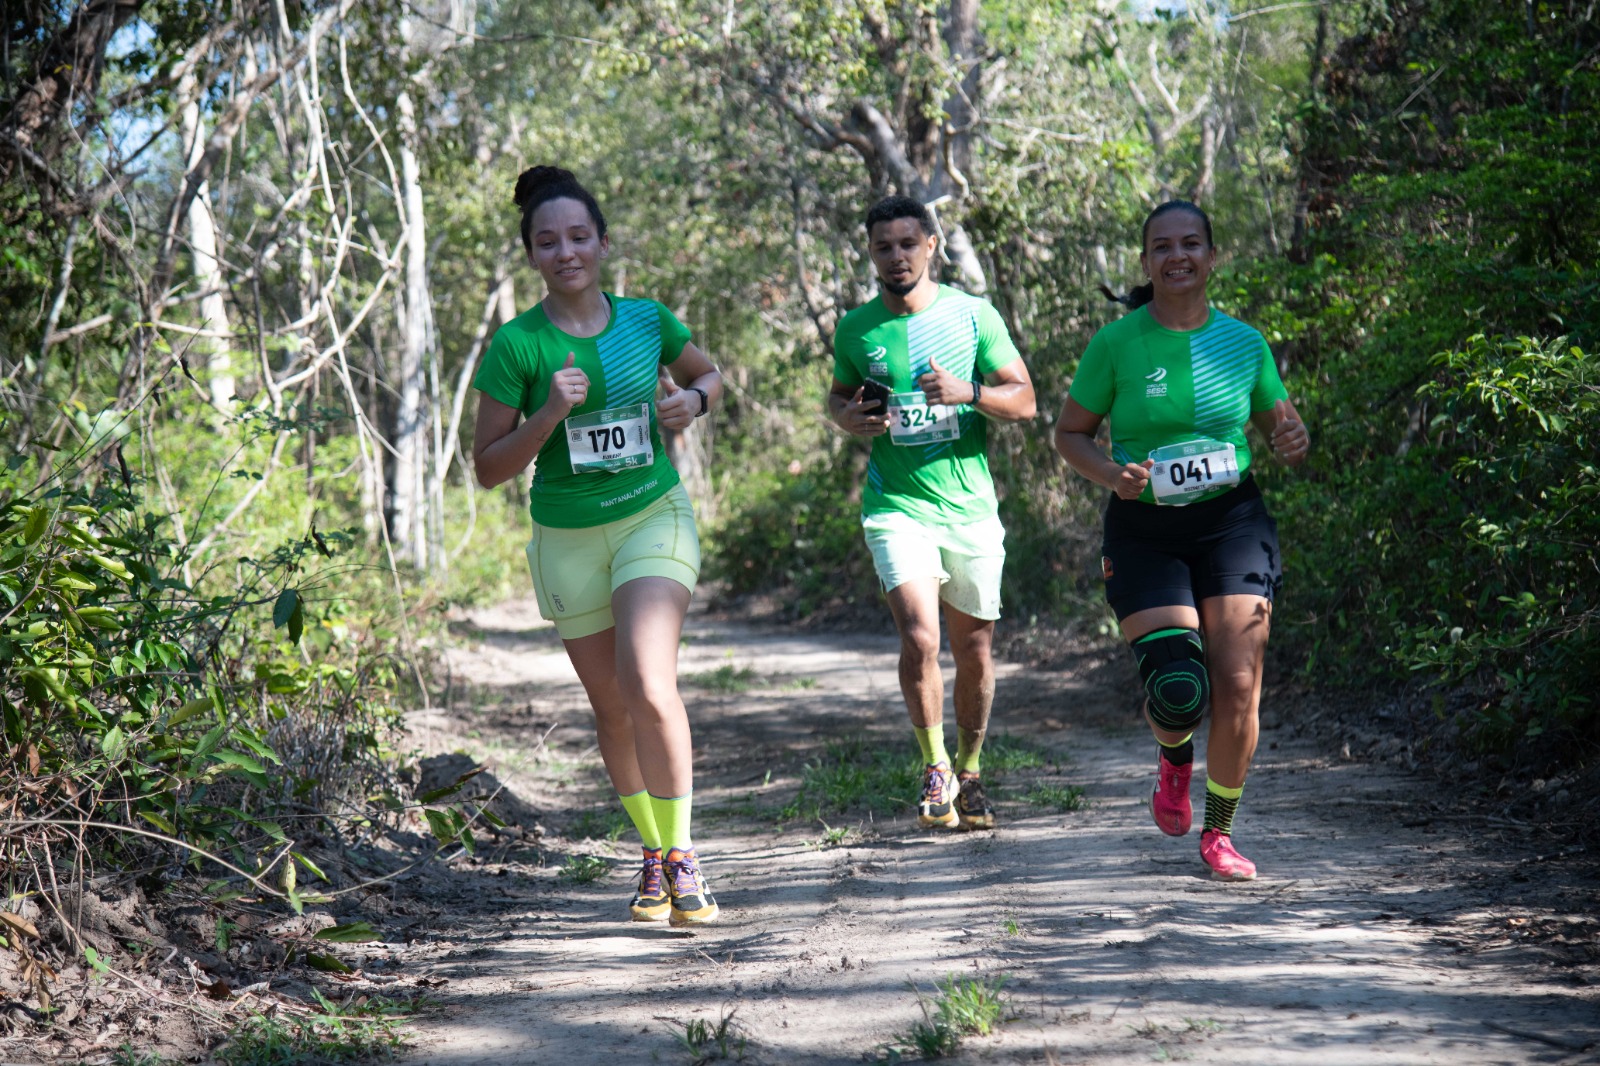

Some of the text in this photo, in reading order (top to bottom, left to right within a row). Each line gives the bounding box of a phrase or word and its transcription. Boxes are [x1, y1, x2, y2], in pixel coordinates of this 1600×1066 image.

[900, 407, 937, 428] 324
[588, 426, 626, 453] 170
[625, 456, 638, 467] 5k
[1170, 458, 1212, 486] 041
[600, 479, 659, 508] PANTANAL/MT/2024
[551, 592, 565, 613] GRIT
